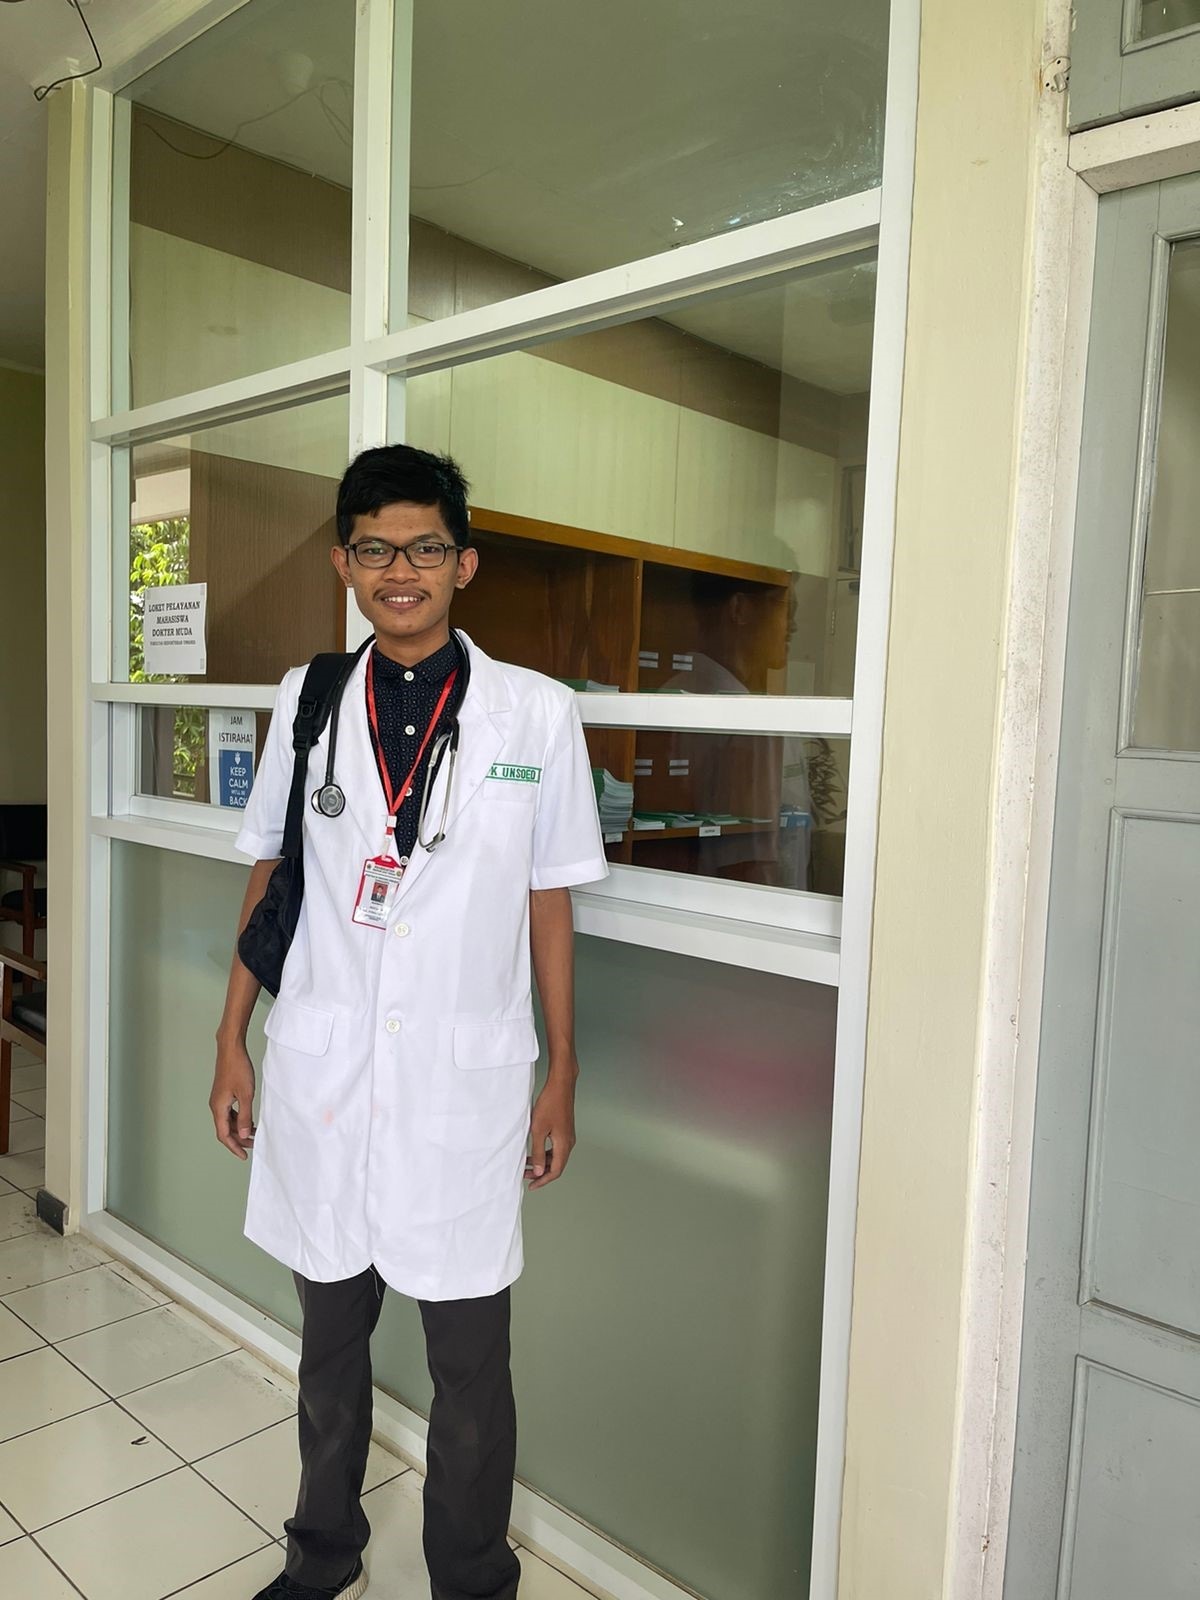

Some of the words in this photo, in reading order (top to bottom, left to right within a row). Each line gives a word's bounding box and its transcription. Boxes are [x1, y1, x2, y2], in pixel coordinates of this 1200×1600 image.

[149, 603, 165, 612] LOKET
[166, 601, 201, 611] PELAYANAN
[156, 615, 189, 624] MAHASISWA
[152, 628, 174, 637] DOKTER
[175, 627, 193, 636] MUDA
[230, 716, 243, 725] JAM
[219, 732, 253, 743] ISTIRAHAT
[230, 766, 246, 776] KEEP
[489, 766, 498, 776] K
[502, 767, 536, 780] UNSOED
[228, 779, 249, 789] CALM
